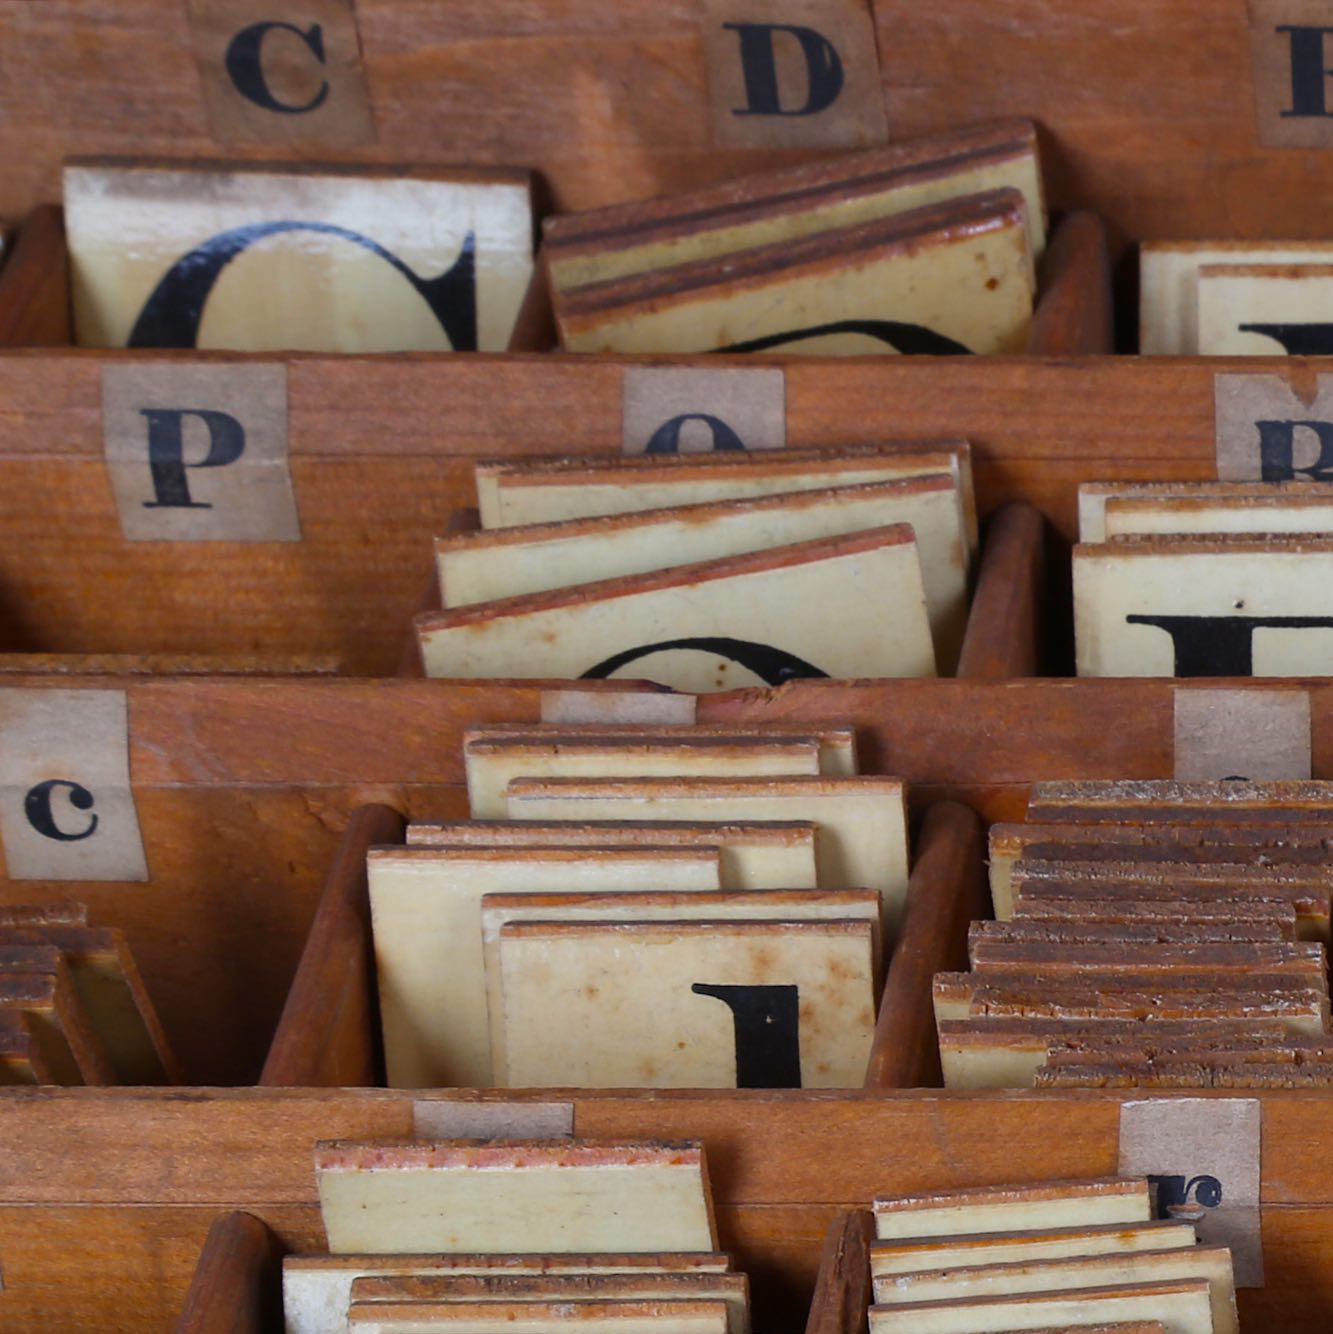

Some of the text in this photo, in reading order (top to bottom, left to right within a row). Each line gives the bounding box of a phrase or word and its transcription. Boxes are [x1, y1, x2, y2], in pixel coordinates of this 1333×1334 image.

[225, 22, 329, 114] C
[723, 23, 845, 117] D
[141, 409, 244, 508] P
[25, 780, 97, 841] c
